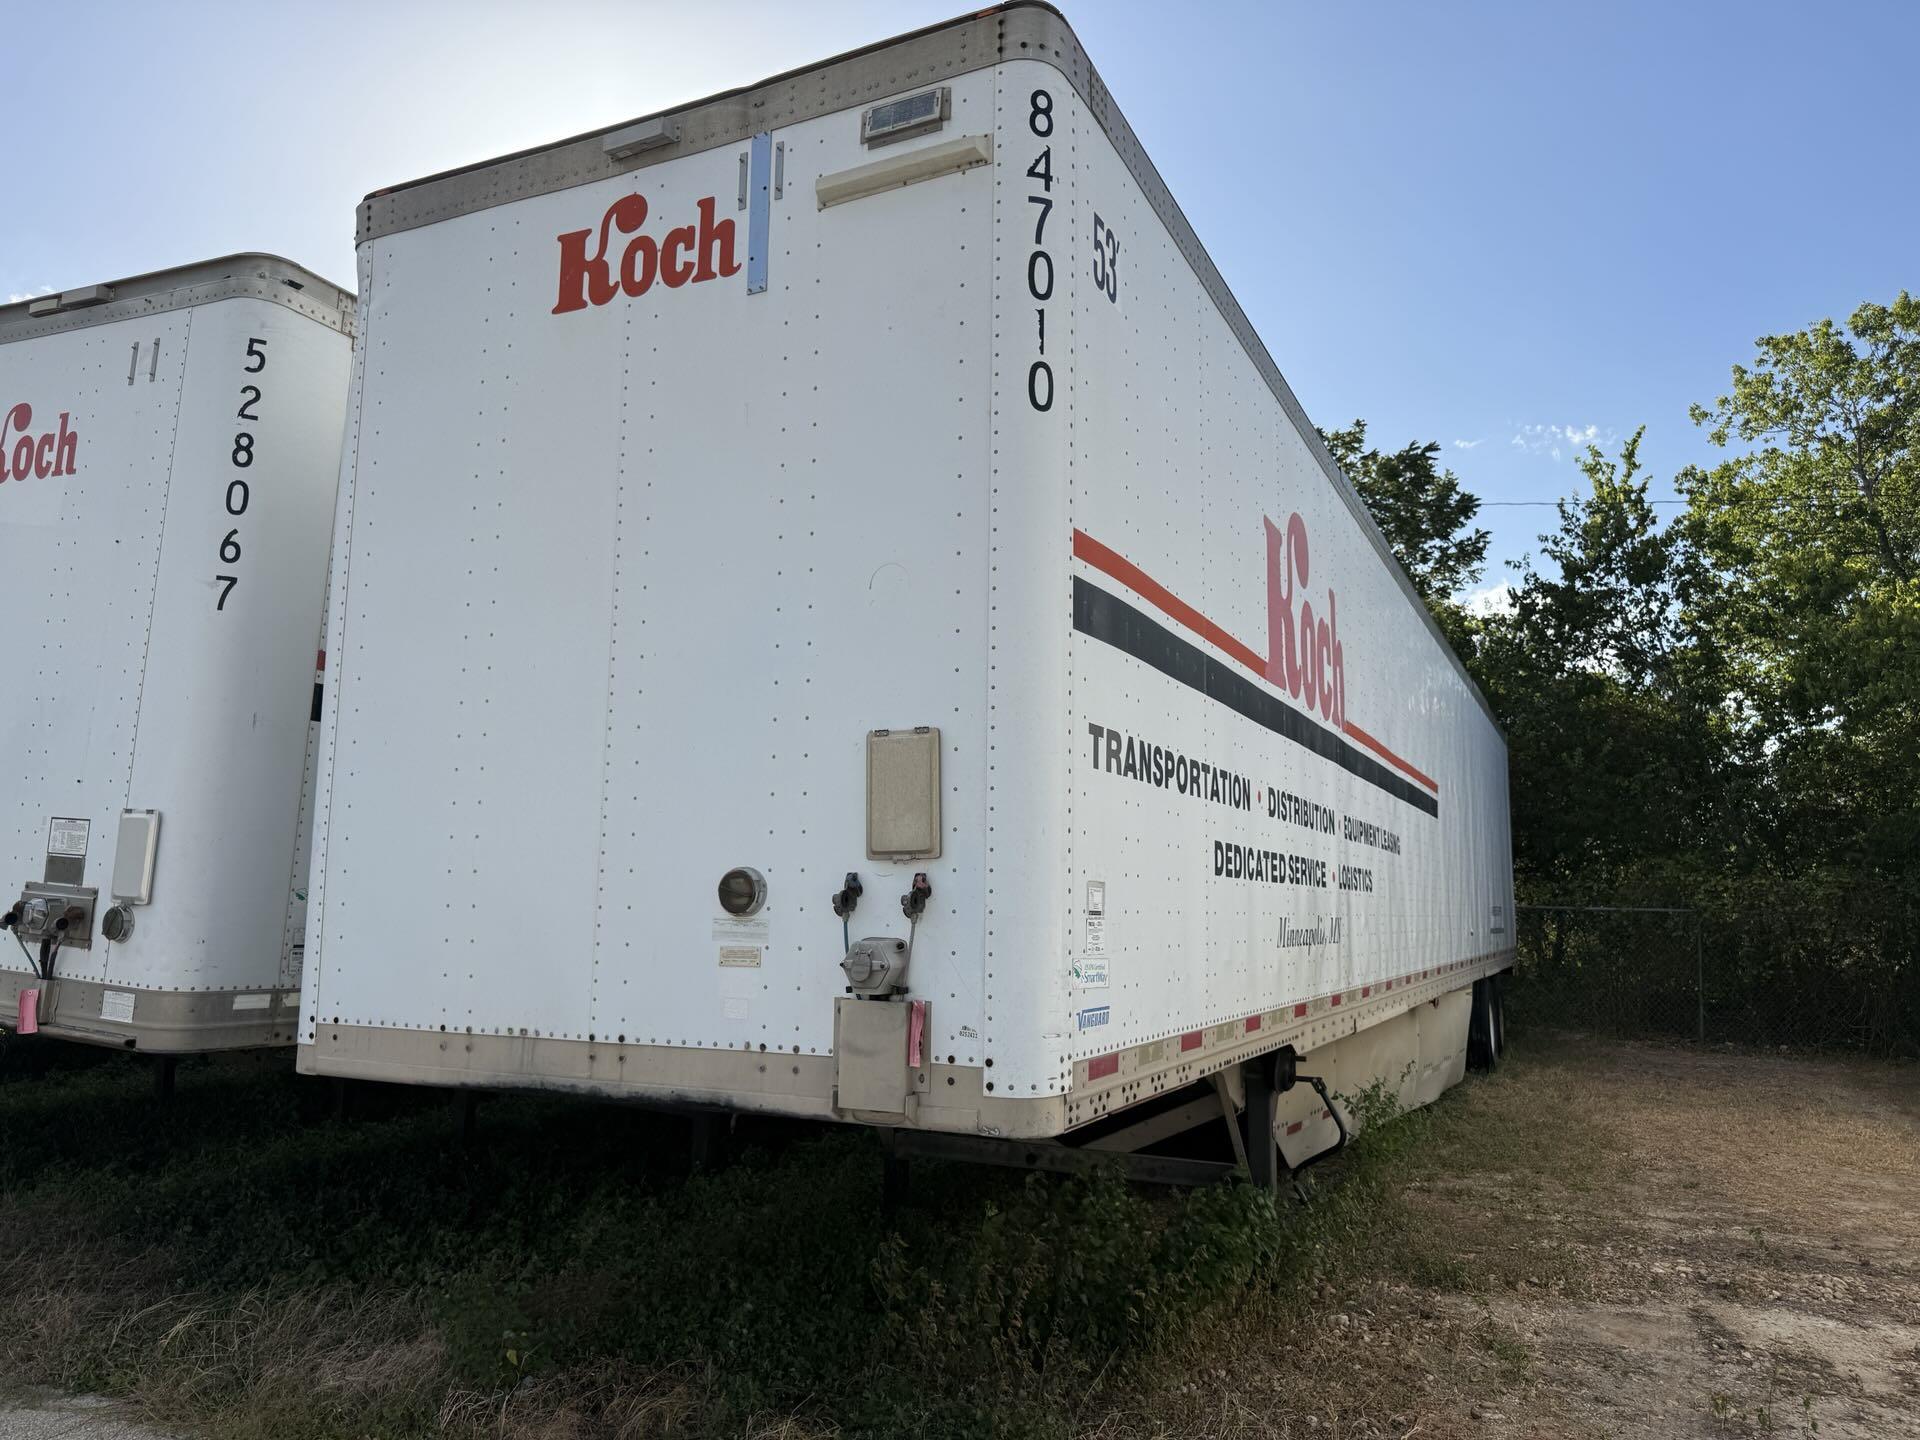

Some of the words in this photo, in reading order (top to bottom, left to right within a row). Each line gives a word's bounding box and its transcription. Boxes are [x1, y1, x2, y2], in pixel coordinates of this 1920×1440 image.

[551, 192, 742, 315] Koch
[1026, 89, 1055, 412] 847010
[1092, 211, 1121, 304] 53'
[215, 337, 268, 611] 528067
[1263, 511, 1346, 733] Koch
[1088, 722, 1251, 812] TRANSPORTATION
[1267, 786, 1336, 836] DISTRIBUTION
[1343, 814, 1380, 849] EQUIPMENT
[1380, 828, 1400, 856] LEASING
[1214, 840, 1287, 884] DEDICATED
[1288, 854, 1327, 888] SERVICE
[1338, 863, 1373, 893] LOGISTICS
[1075, 1005, 1111, 1031] VANGUARD
